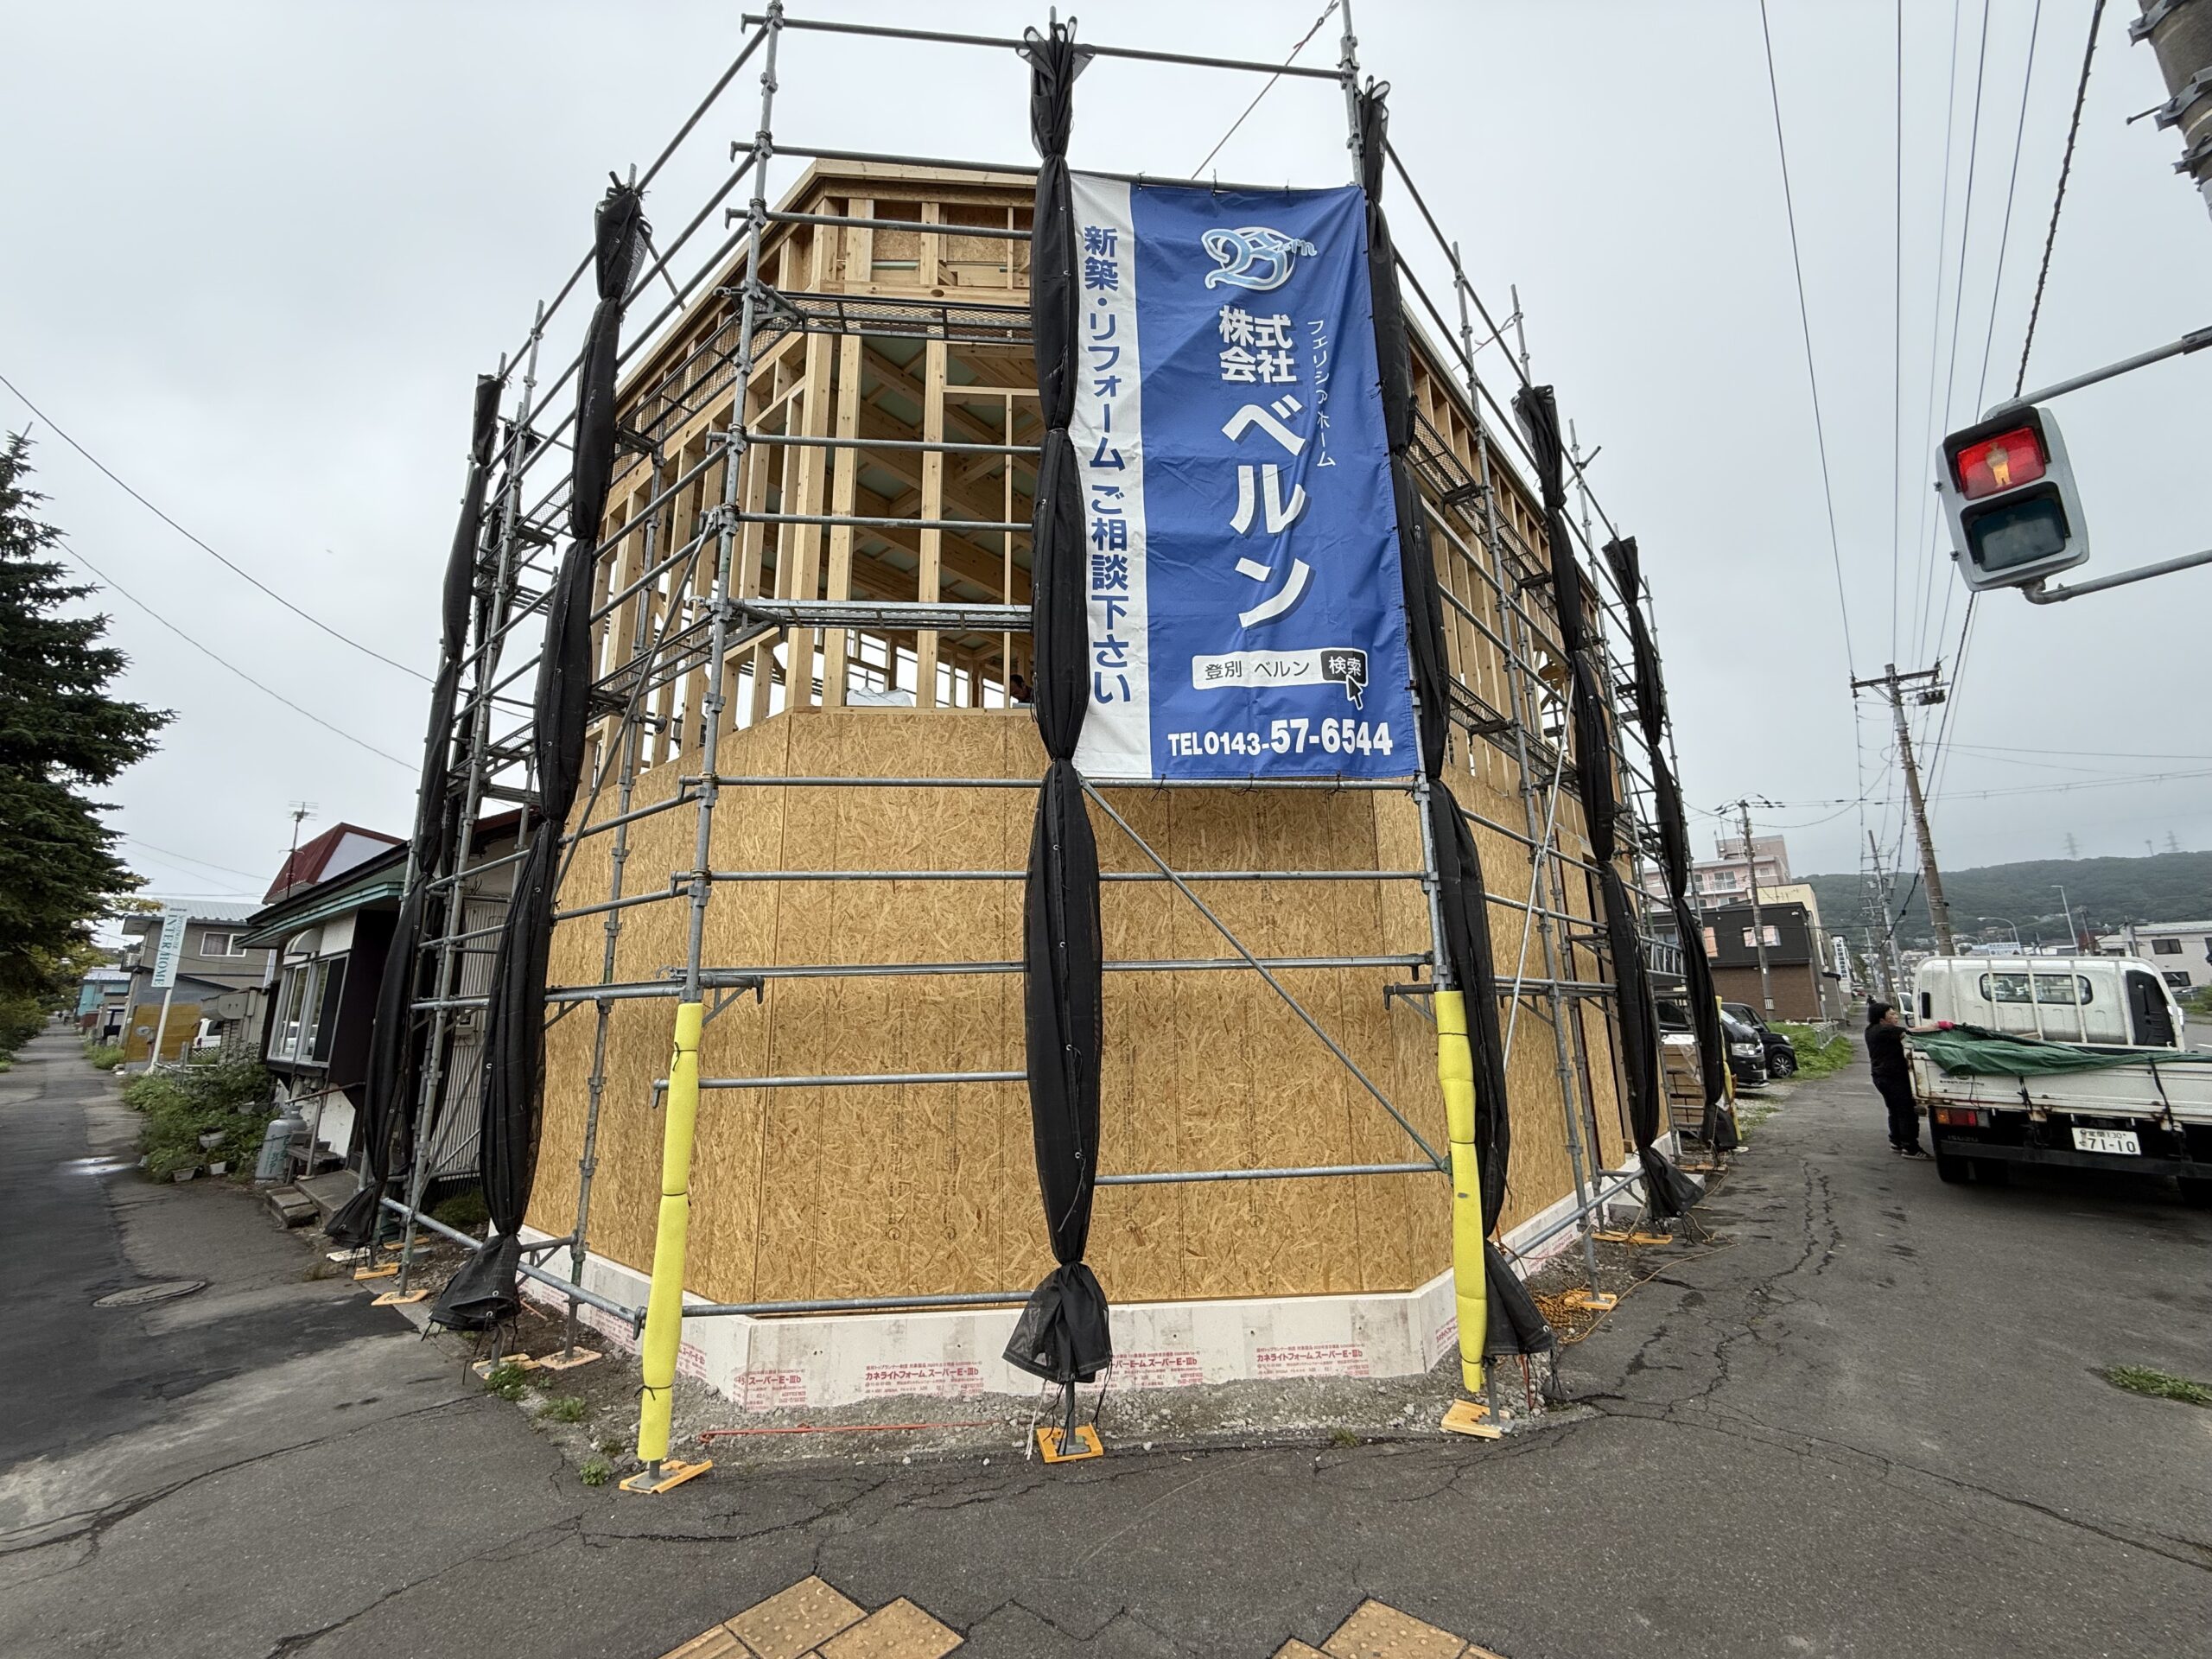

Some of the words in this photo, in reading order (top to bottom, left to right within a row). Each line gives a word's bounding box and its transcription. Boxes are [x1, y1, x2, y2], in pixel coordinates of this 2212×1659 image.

[1221, 393, 1311, 628] ベルン
[1205, 659, 1243, 681] 登別
[1253, 660, 1310, 677] ベルン
[1328, 655, 1362, 677] 検索
[162, 913, 178, 950] INTER
[2087, 1137, 2137, 1153] 71-10
[1256, 1352, 1313, 1363] カネライトフォーム
[865, 1370, 925, 1381] カネライトフォーム
